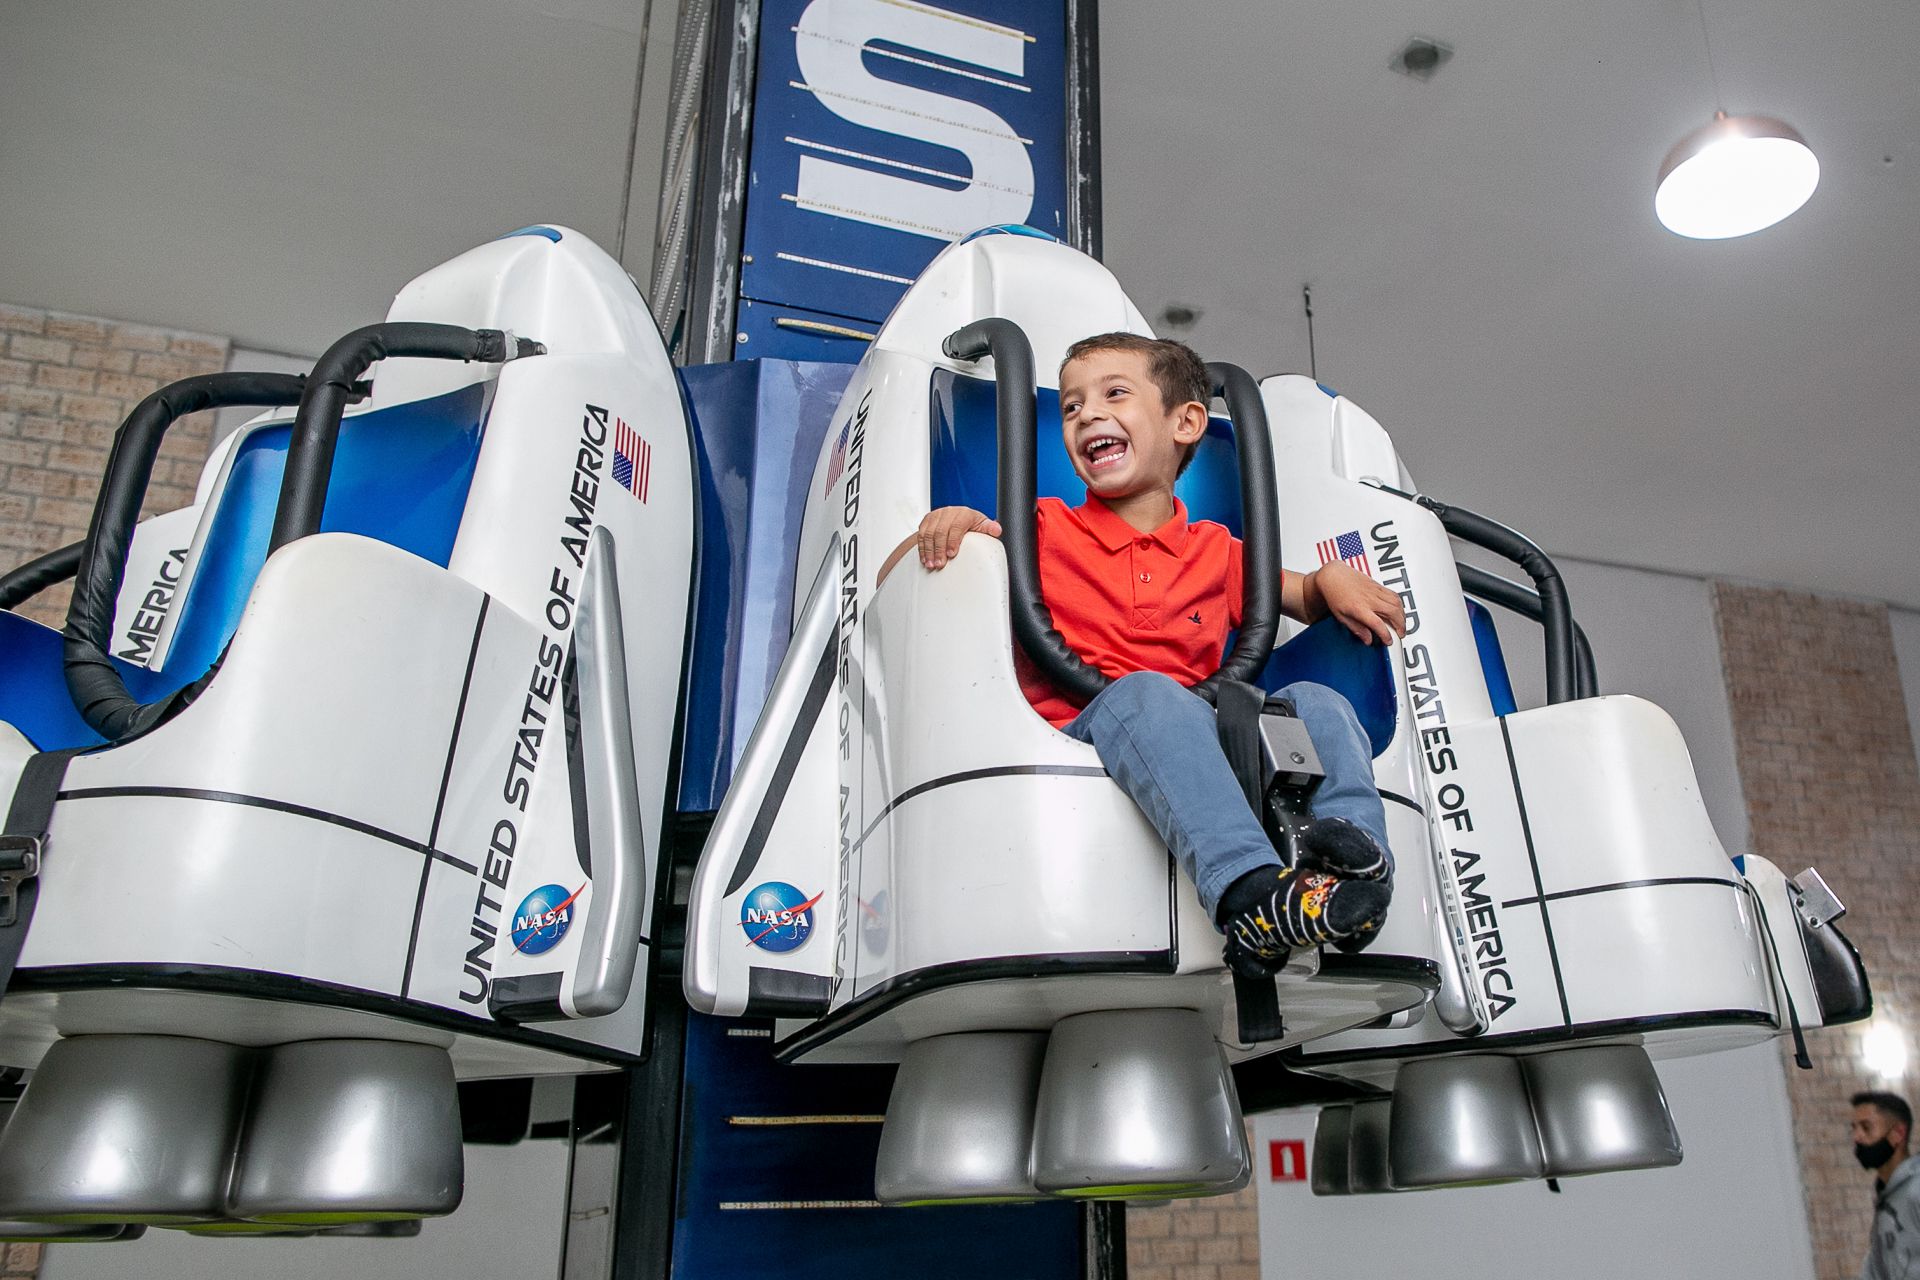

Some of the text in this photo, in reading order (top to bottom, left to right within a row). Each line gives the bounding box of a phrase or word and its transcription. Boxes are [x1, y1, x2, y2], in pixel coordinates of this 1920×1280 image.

[118, 548, 189, 663] MERICA
[1370, 520, 1420, 636] UNITED
[459, 403, 609, 1005] UNITED STATES OF AMERICA
[832, 388, 873, 1000] UNITED STATES OF AMERICA
[1403, 644, 1458, 775] STATES
[1438, 783, 1474, 832] OF
[516, 908, 569, 931] NASA
[747, 907, 809, 928] NASA
[1451, 848, 1517, 1022] AMERICA
